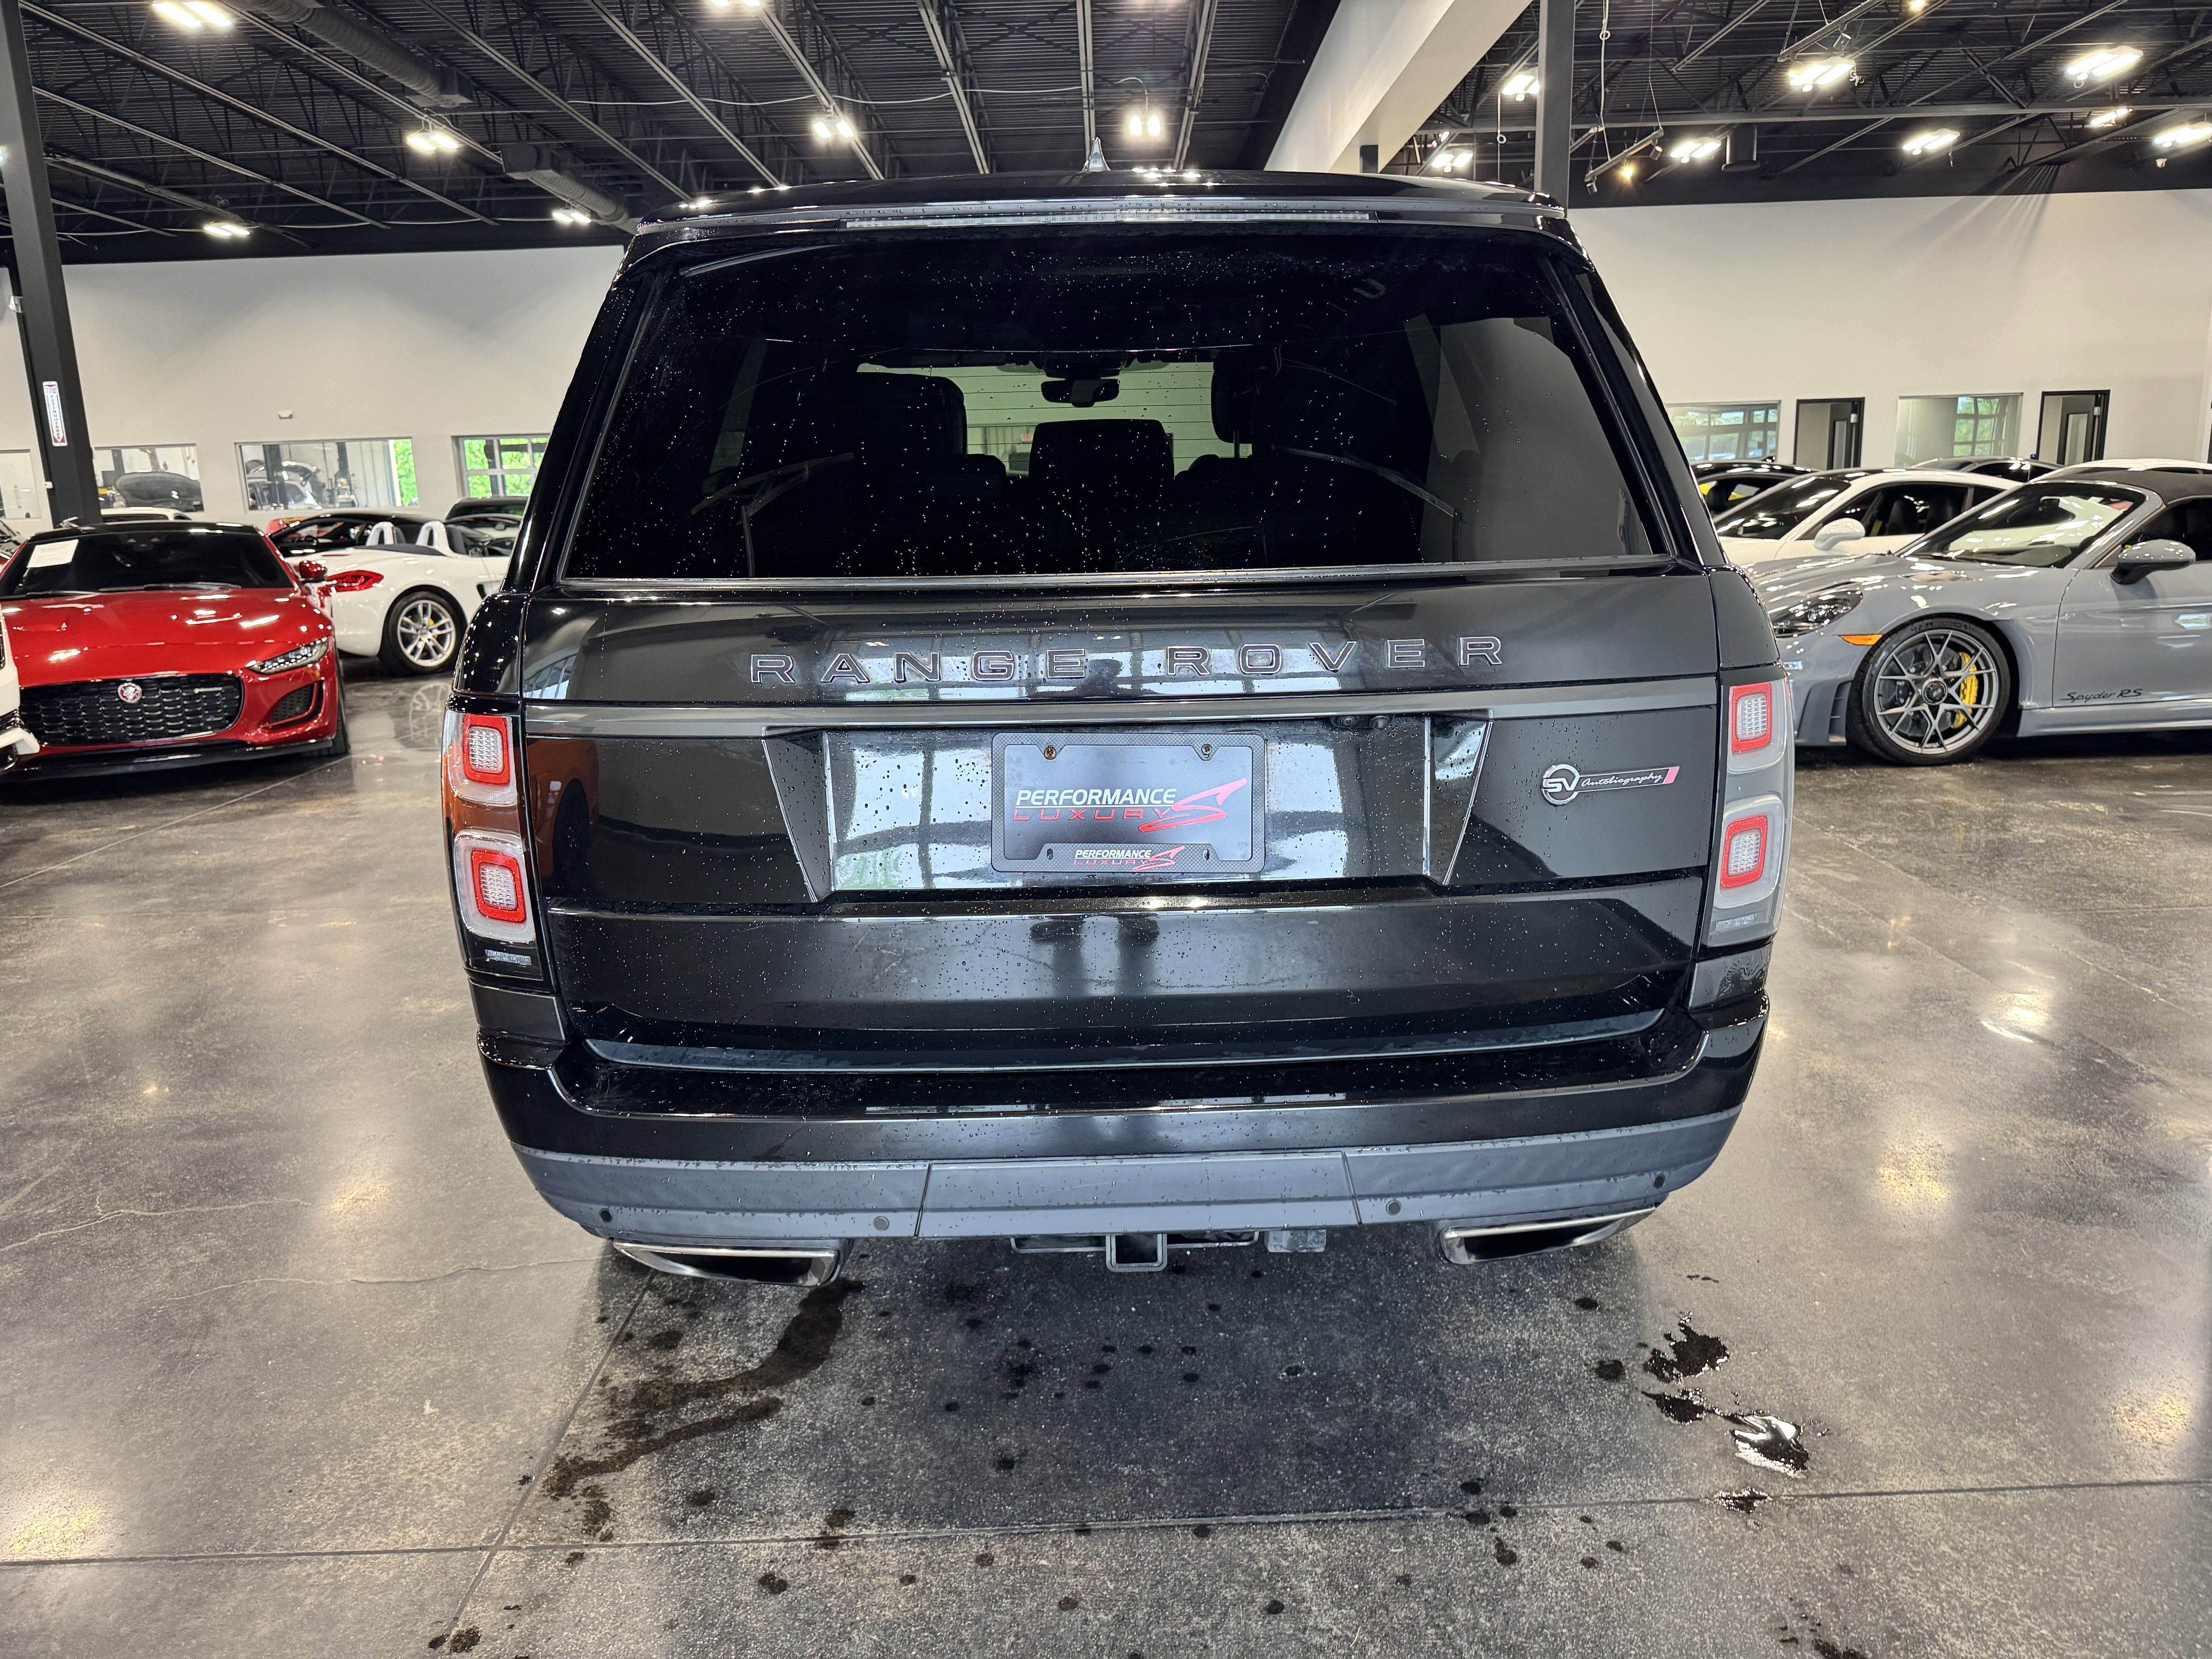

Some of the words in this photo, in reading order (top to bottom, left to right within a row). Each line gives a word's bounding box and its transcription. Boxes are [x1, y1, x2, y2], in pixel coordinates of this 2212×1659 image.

[750, 648, 1085, 684] RANGE
[1166, 636, 1502, 675] ROVER
[2059, 690, 2116, 703] Spyder
[2116, 688, 2143, 698] RS
[1581, 772, 1663, 787] Autobiography
[1016, 788, 1177, 805] PERFORMANCE
[1075, 850, 1152, 858] PERFORMANCE
